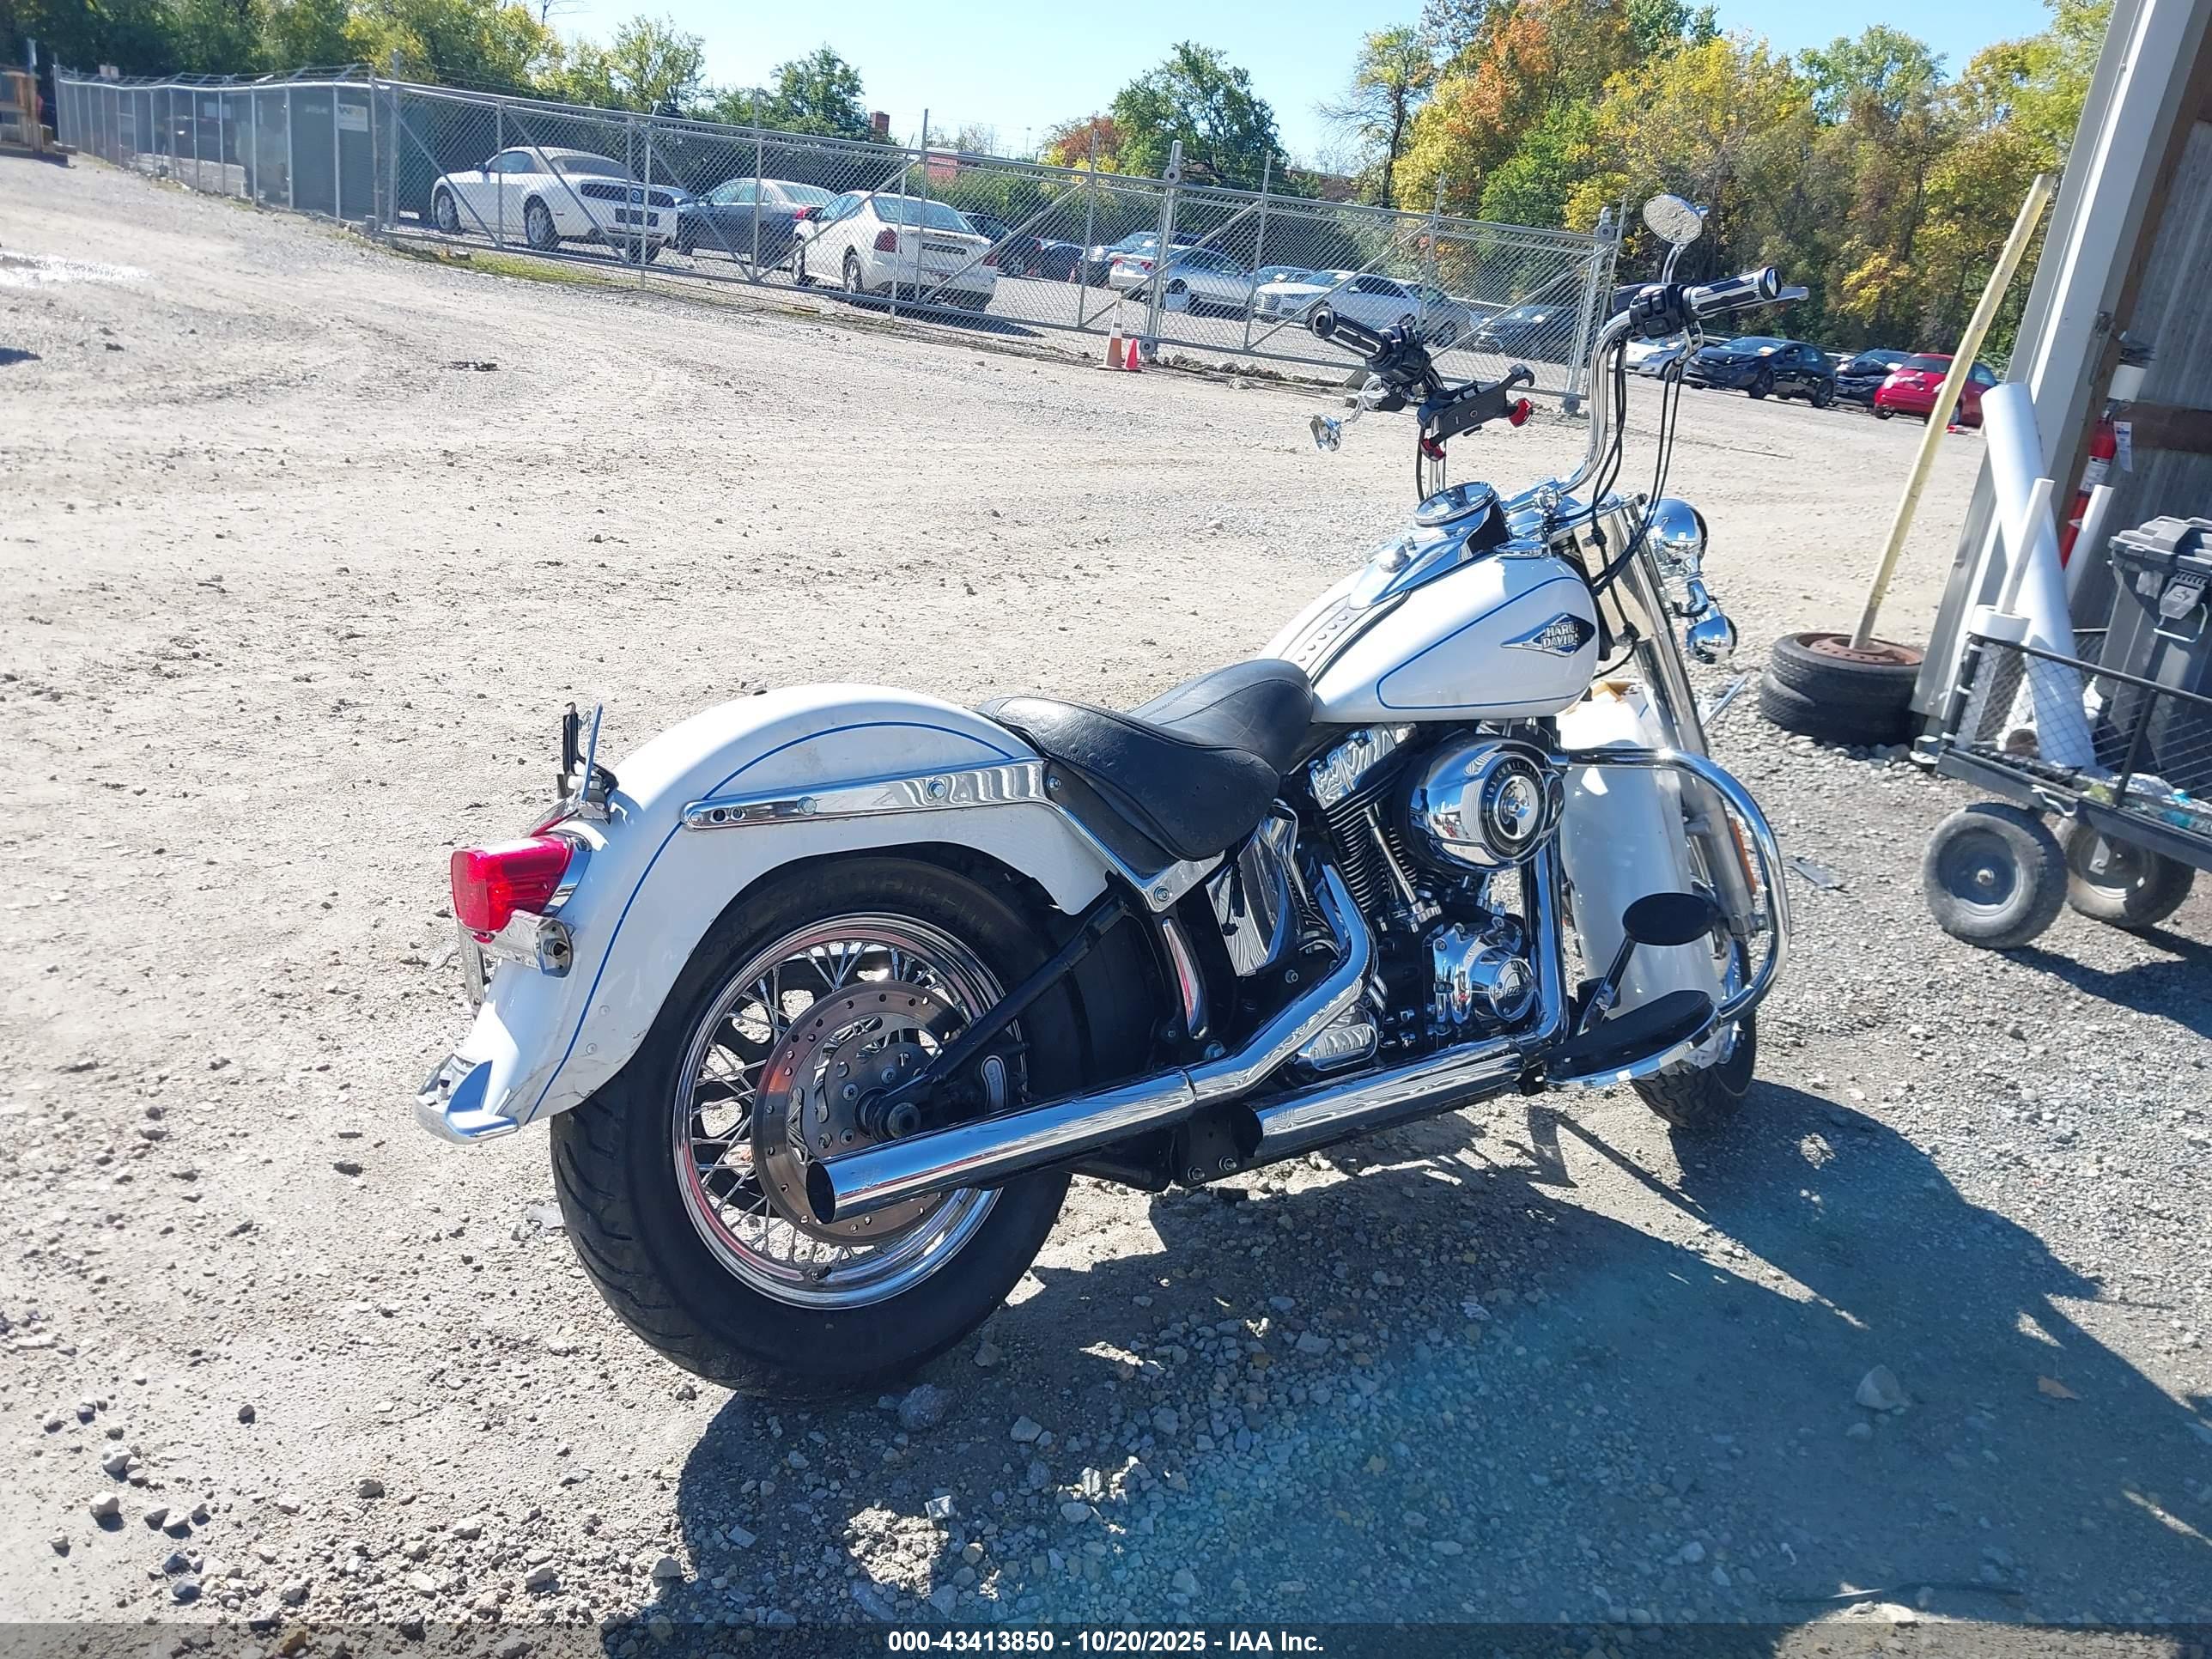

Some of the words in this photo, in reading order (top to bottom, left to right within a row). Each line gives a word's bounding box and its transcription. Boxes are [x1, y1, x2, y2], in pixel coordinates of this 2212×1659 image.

[1546, 622, 1579, 637] HARL
[1542, 634, 1579, 648] DAVIDS
[1497, 762, 1520, 778] CUBIC
